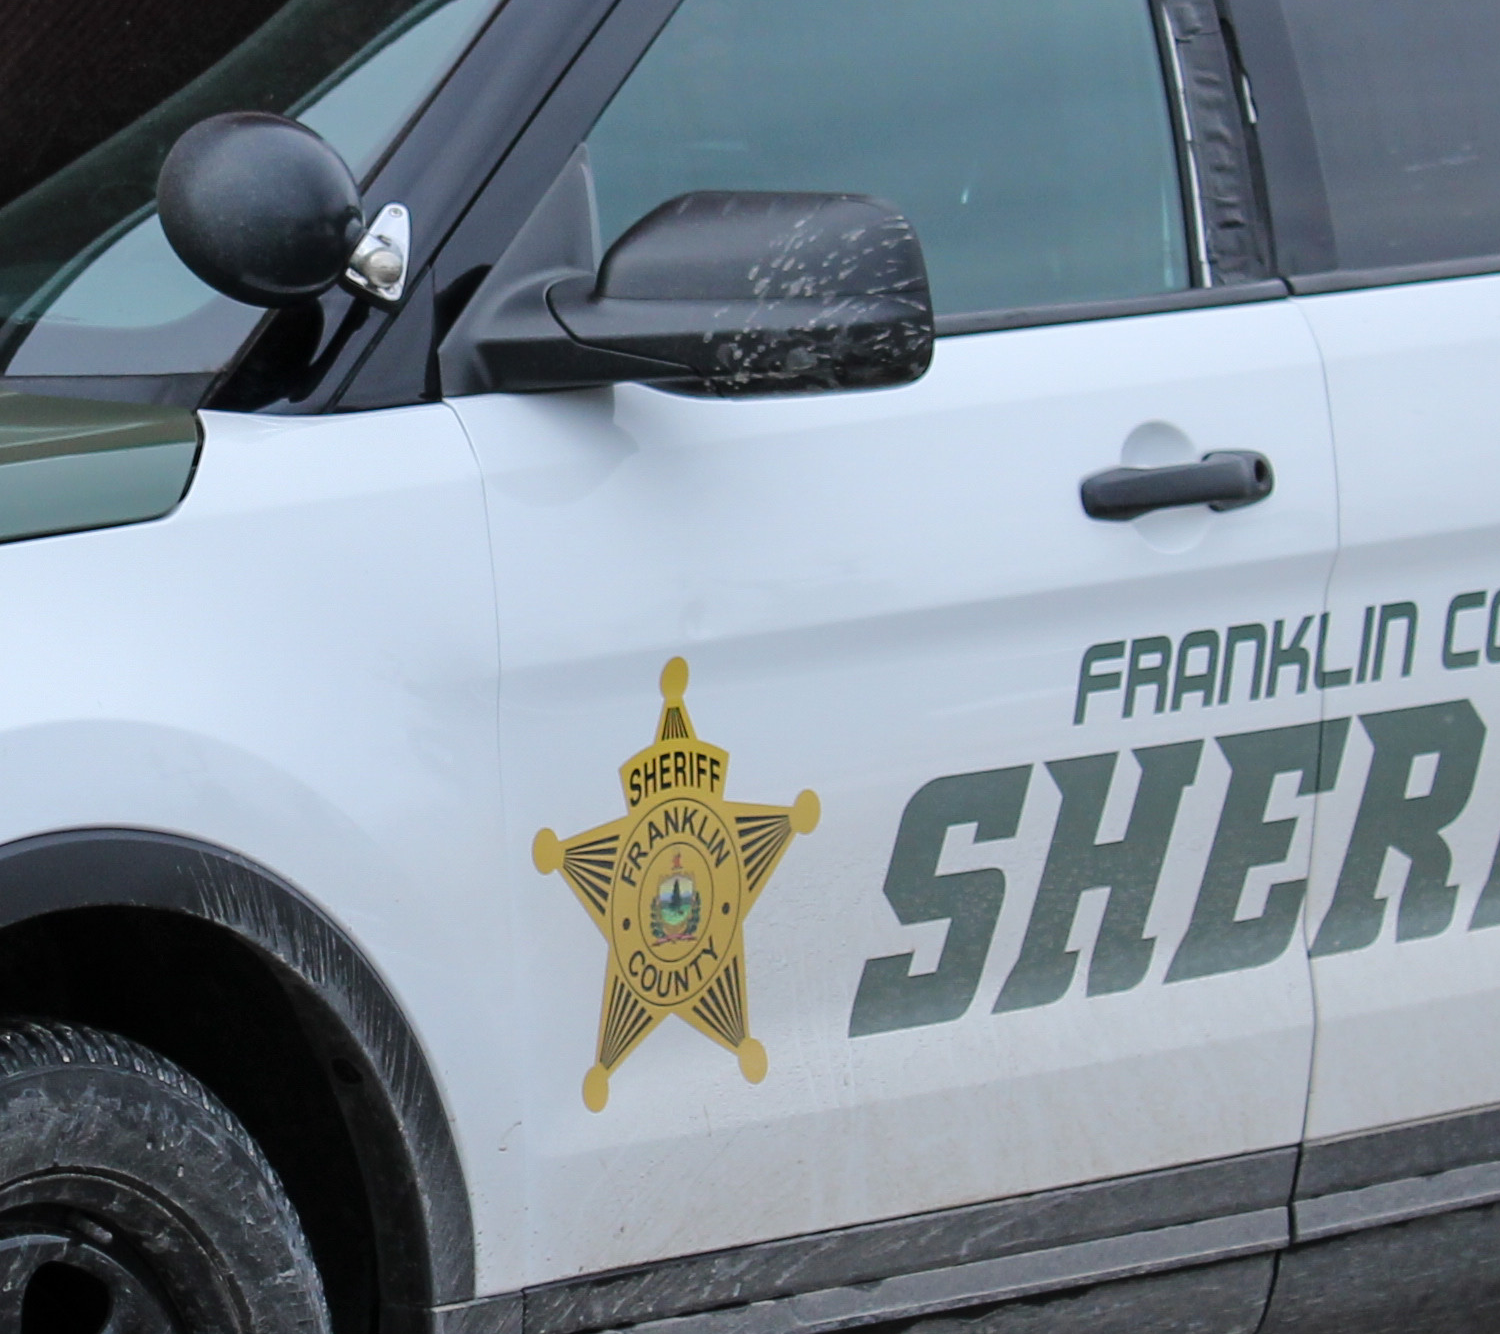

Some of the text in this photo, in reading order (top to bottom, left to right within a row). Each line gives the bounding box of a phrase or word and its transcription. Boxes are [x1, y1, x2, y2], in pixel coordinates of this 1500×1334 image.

[1073, 600, 1419, 725] FRANKLIN
[628, 750, 722, 808] SHERIFF
[620, 805, 732, 888] FRANKLIN
[627, 935, 720, 999] COUNTY
